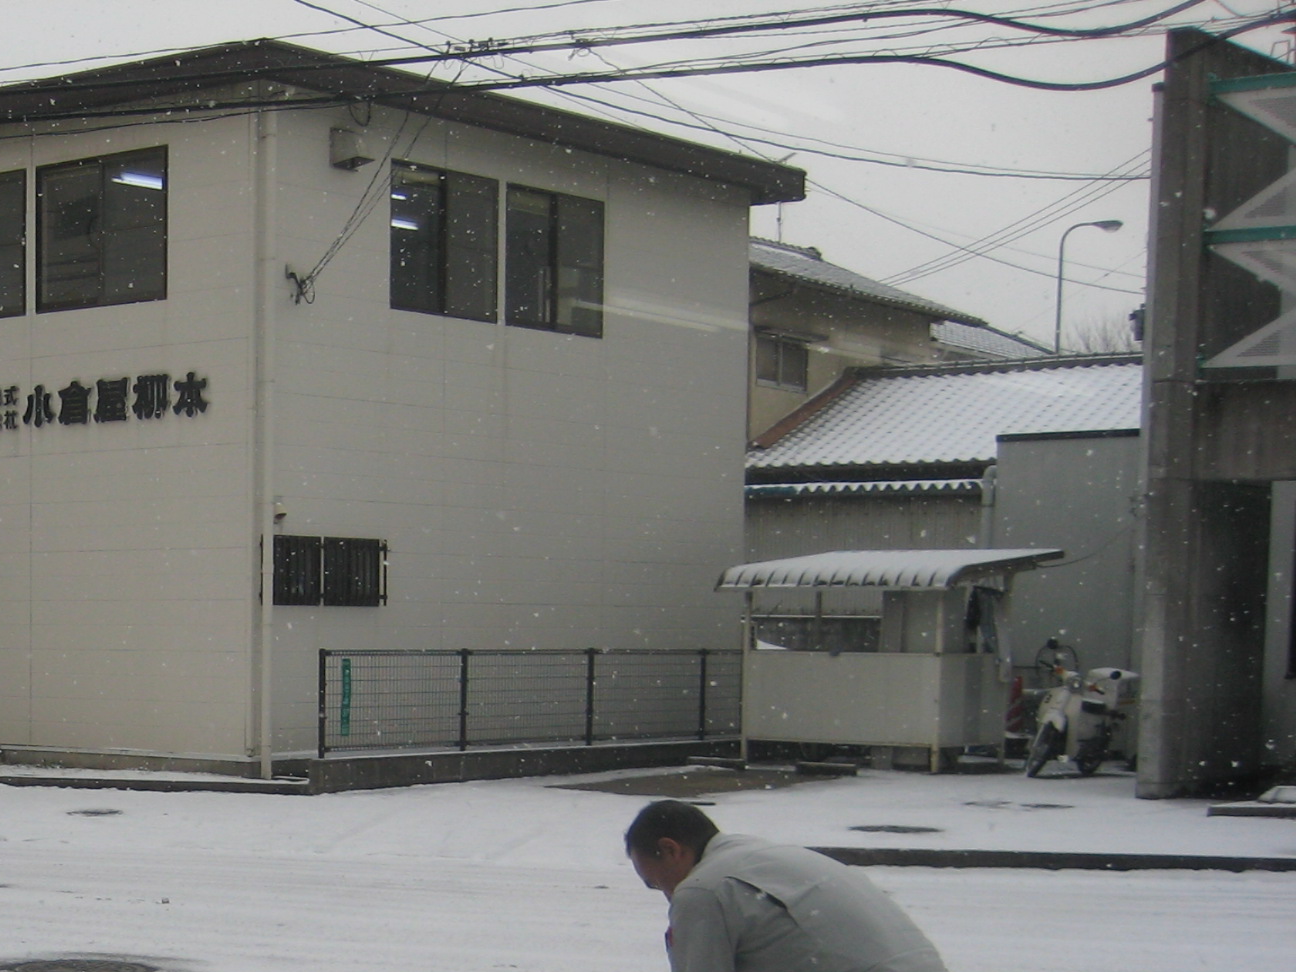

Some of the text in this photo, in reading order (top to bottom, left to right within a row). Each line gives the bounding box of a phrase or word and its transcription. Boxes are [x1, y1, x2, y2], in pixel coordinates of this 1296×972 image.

[22, 371, 208, 428] 小倉屋柳本
